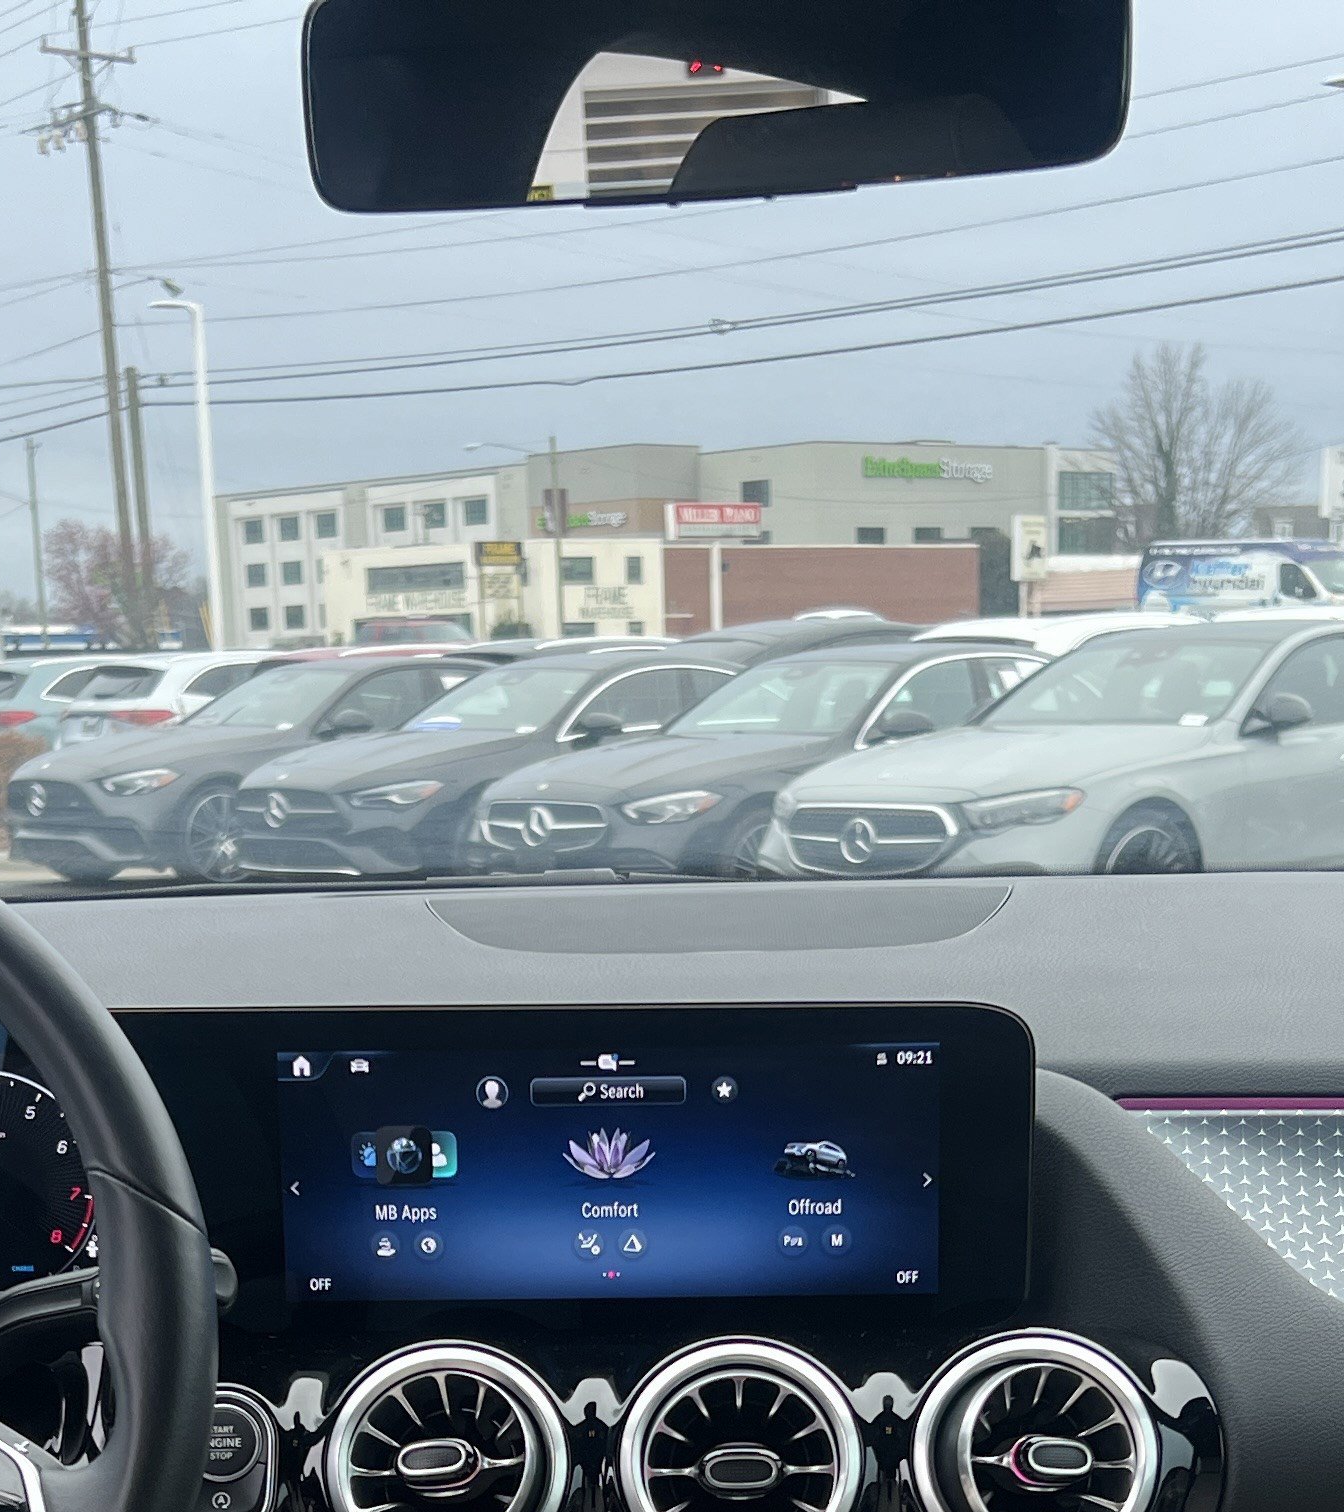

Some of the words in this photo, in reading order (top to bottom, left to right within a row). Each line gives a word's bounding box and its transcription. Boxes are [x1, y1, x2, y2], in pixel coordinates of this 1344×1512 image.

[896, 1050, 933, 1065] 09:21
[599, 1082, 645, 1100] Search
[24, 1105, 37, 1120] 5
[56, 1139, 68, 1155] 6
[69, 1186, 82, 1201] 7
[375, 1204, 398, 1221] MB
[401, 1204, 438, 1224] Apps
[580, 1201, 639, 1219] Comfort
[788, 1198, 843, 1216] Offroad
[49, 1229, 63, 1244] 8
[830, 1233, 844, 1247] M
[309, 1277, 332, 1291] OFF
[896, 1270, 920, 1284] OFF
[209, 1437, 242, 1448] NGINE
[209, 1452, 233, 1460] STOP
